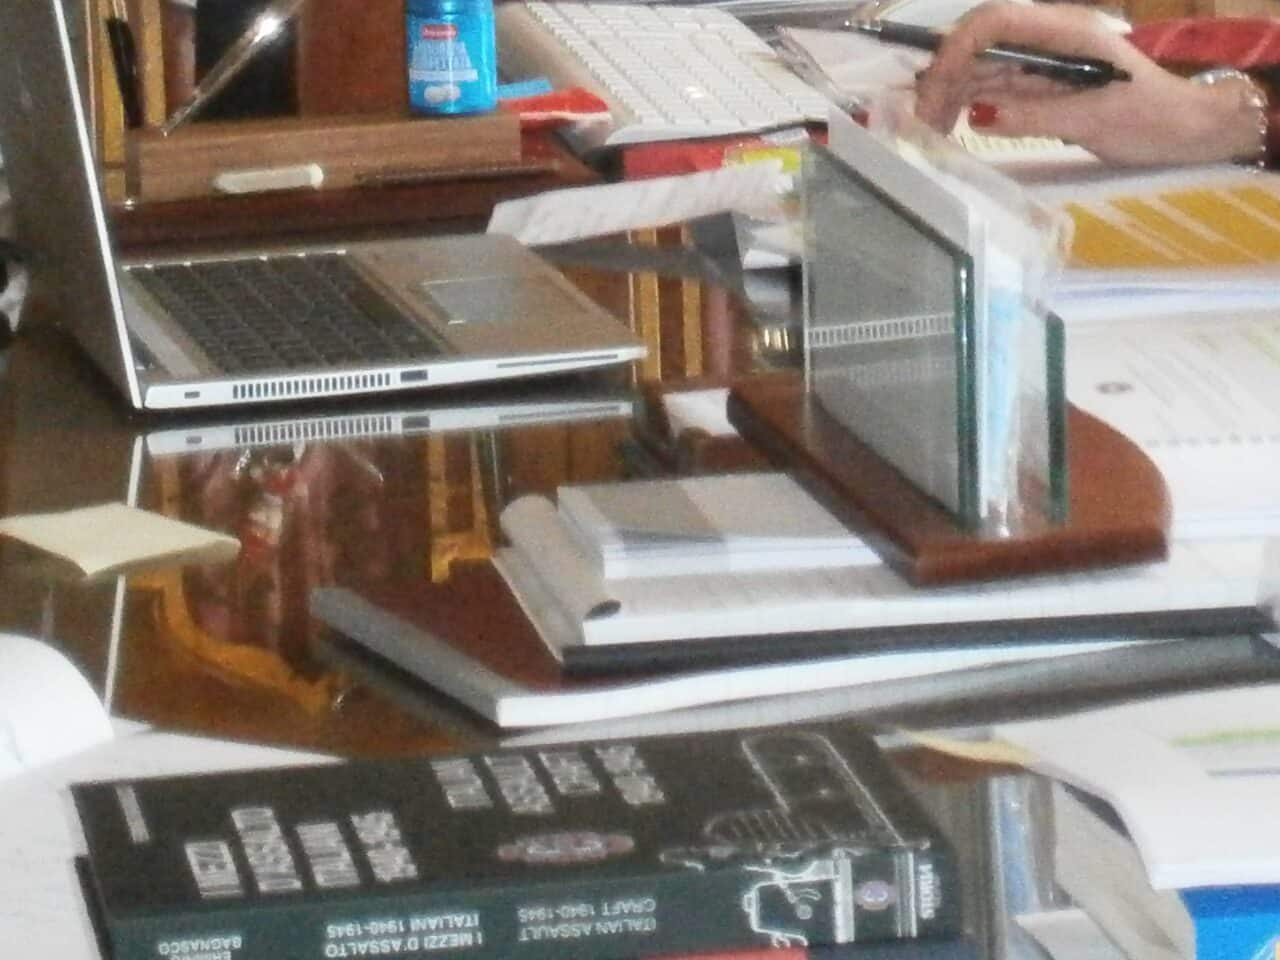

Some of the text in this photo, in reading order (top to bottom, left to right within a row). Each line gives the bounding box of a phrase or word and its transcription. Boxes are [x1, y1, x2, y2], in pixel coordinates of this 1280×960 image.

[602, 899, 657, 916] CRAFT
[326, 913, 480, 938] ITALIANI 1940-1945
[519, 917, 656, 941] ITALIAN ASSAULT
[158, 936, 242, 956] BAGNASCO
[325, 936, 420, 957] D'ASSALTO
[423, 932, 473, 949] MEZZI
